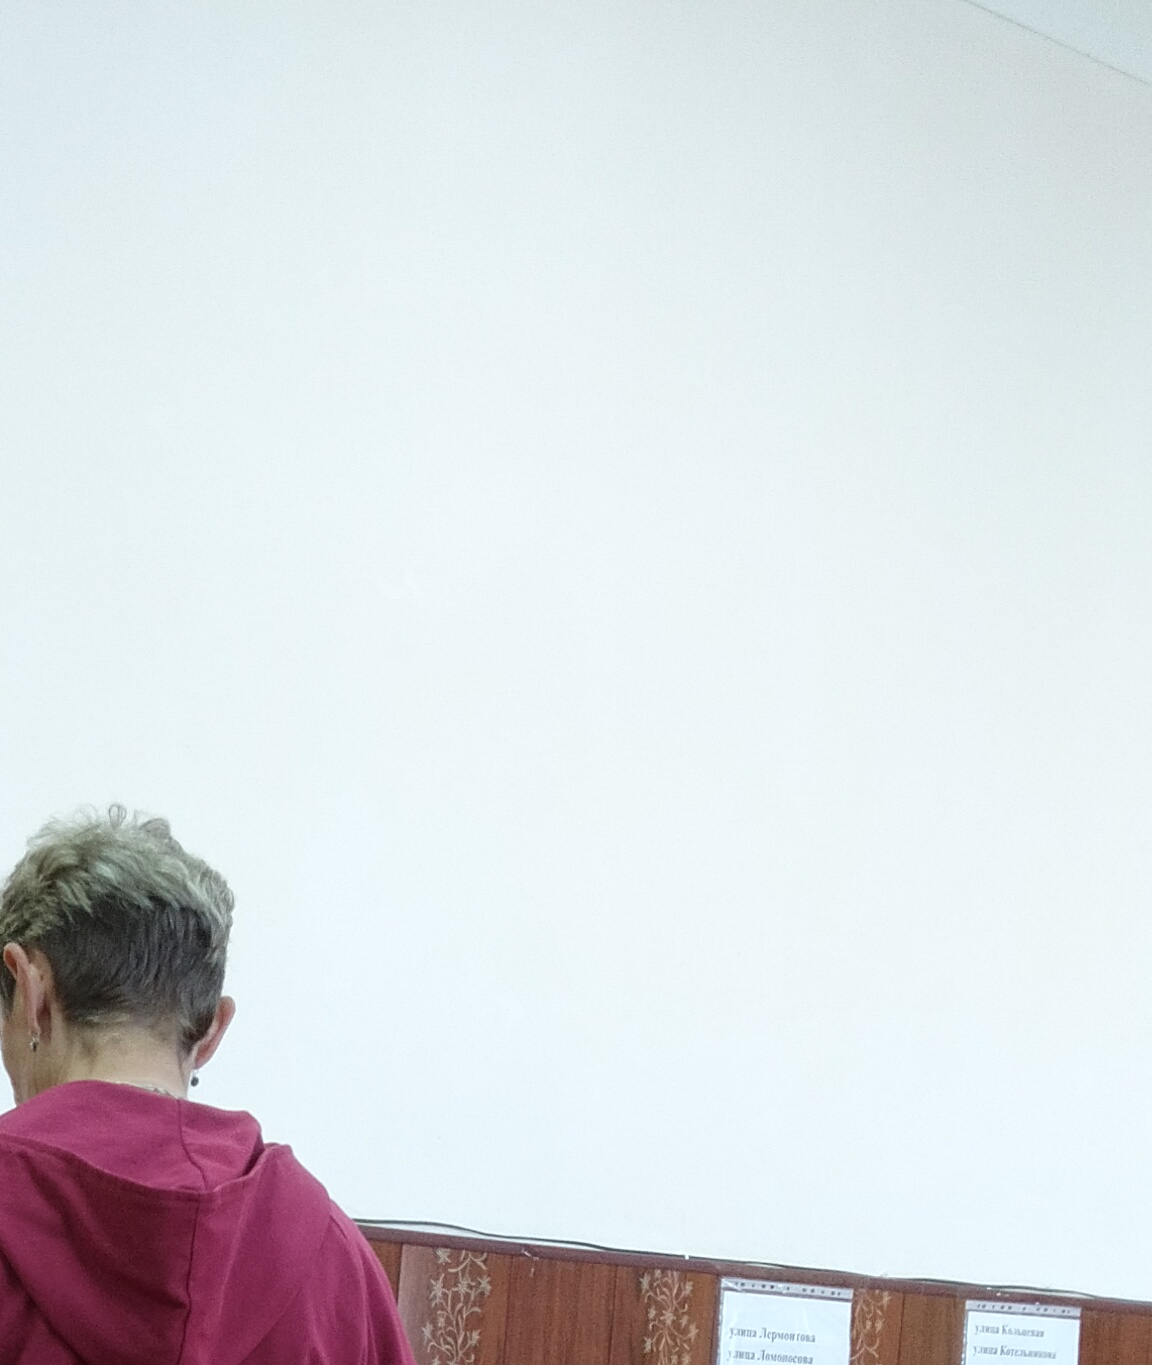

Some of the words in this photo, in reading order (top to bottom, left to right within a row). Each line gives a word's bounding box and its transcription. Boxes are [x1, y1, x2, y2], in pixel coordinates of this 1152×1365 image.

[729, 1327, 757, 1339] улица
[759, 1328, 816, 1343] Лермонтова
[727, 1349, 756, 1361] улица
[757, 1350, 814, 1364] Ломоносова
